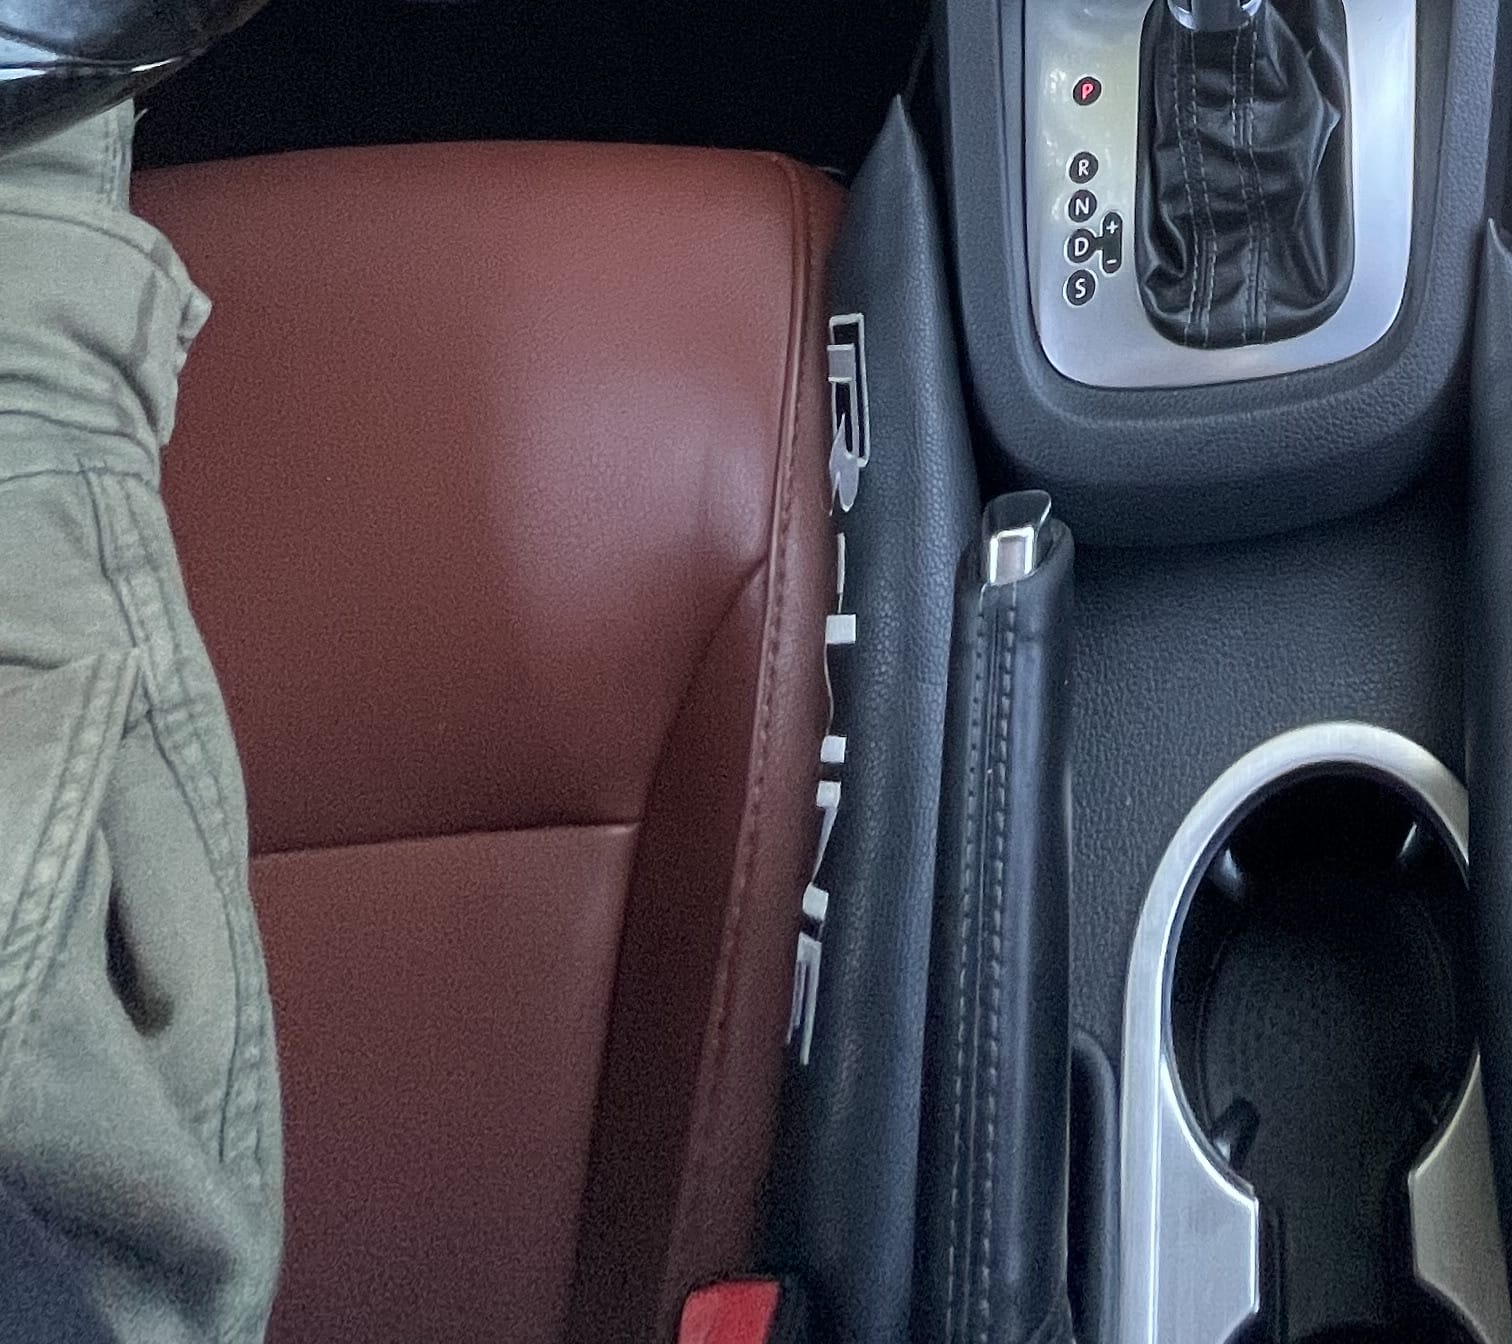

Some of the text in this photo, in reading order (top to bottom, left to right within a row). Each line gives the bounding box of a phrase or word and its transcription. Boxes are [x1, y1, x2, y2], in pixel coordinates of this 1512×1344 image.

[1082, 83, 1093, 100] P
[1078, 160, 1089, 176] R
[1075, 198, 1090, 215] N
[1074, 237, 1089, 254] D
[1074, 277, 1086, 299] S
